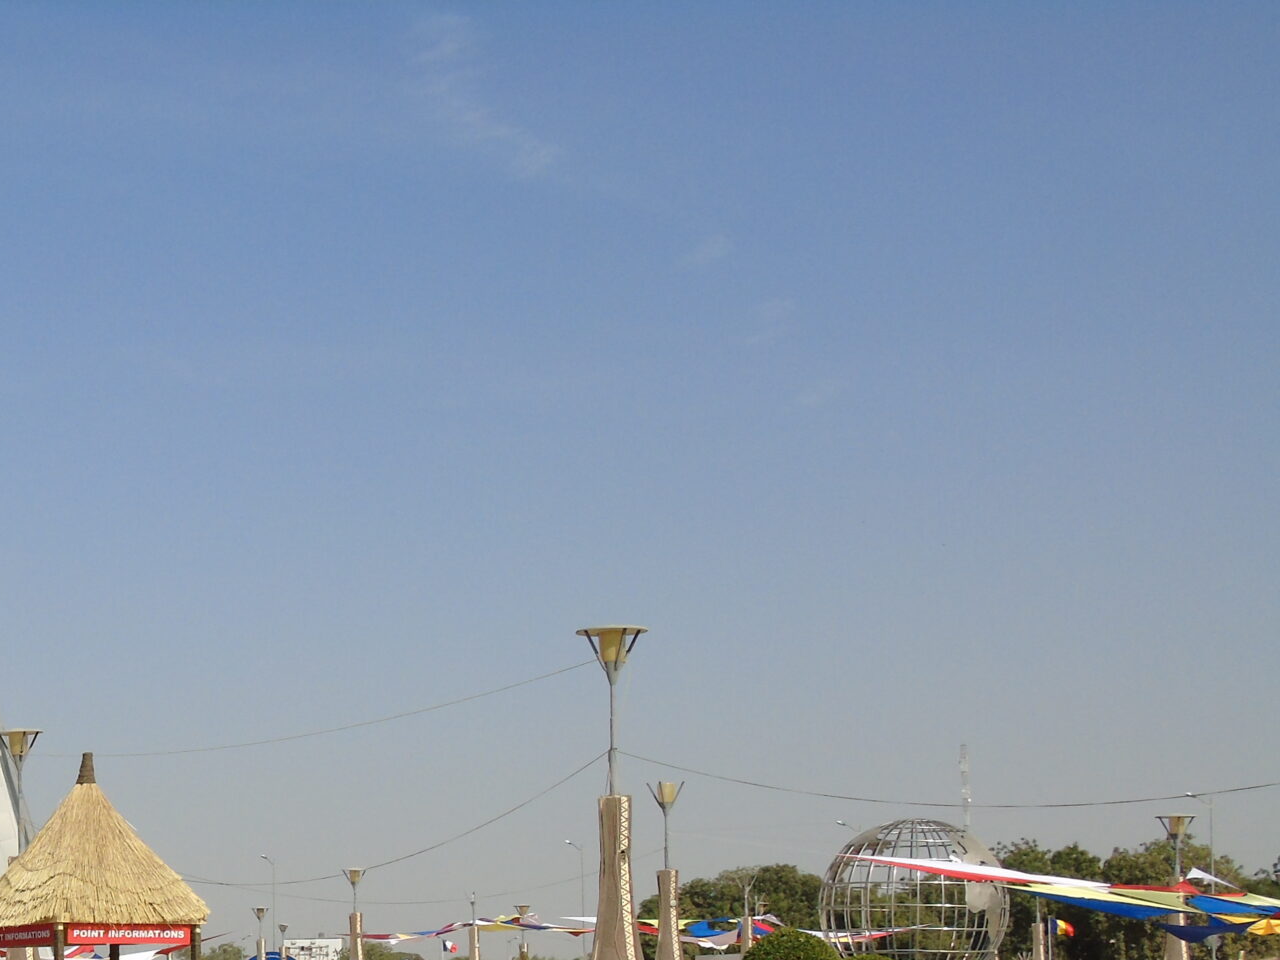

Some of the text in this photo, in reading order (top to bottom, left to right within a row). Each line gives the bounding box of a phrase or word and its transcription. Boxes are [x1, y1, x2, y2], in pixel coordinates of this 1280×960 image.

[4, 930, 50, 940] INFORMATIONS
[73, 929, 185, 939] POINT INFORMATIONS
